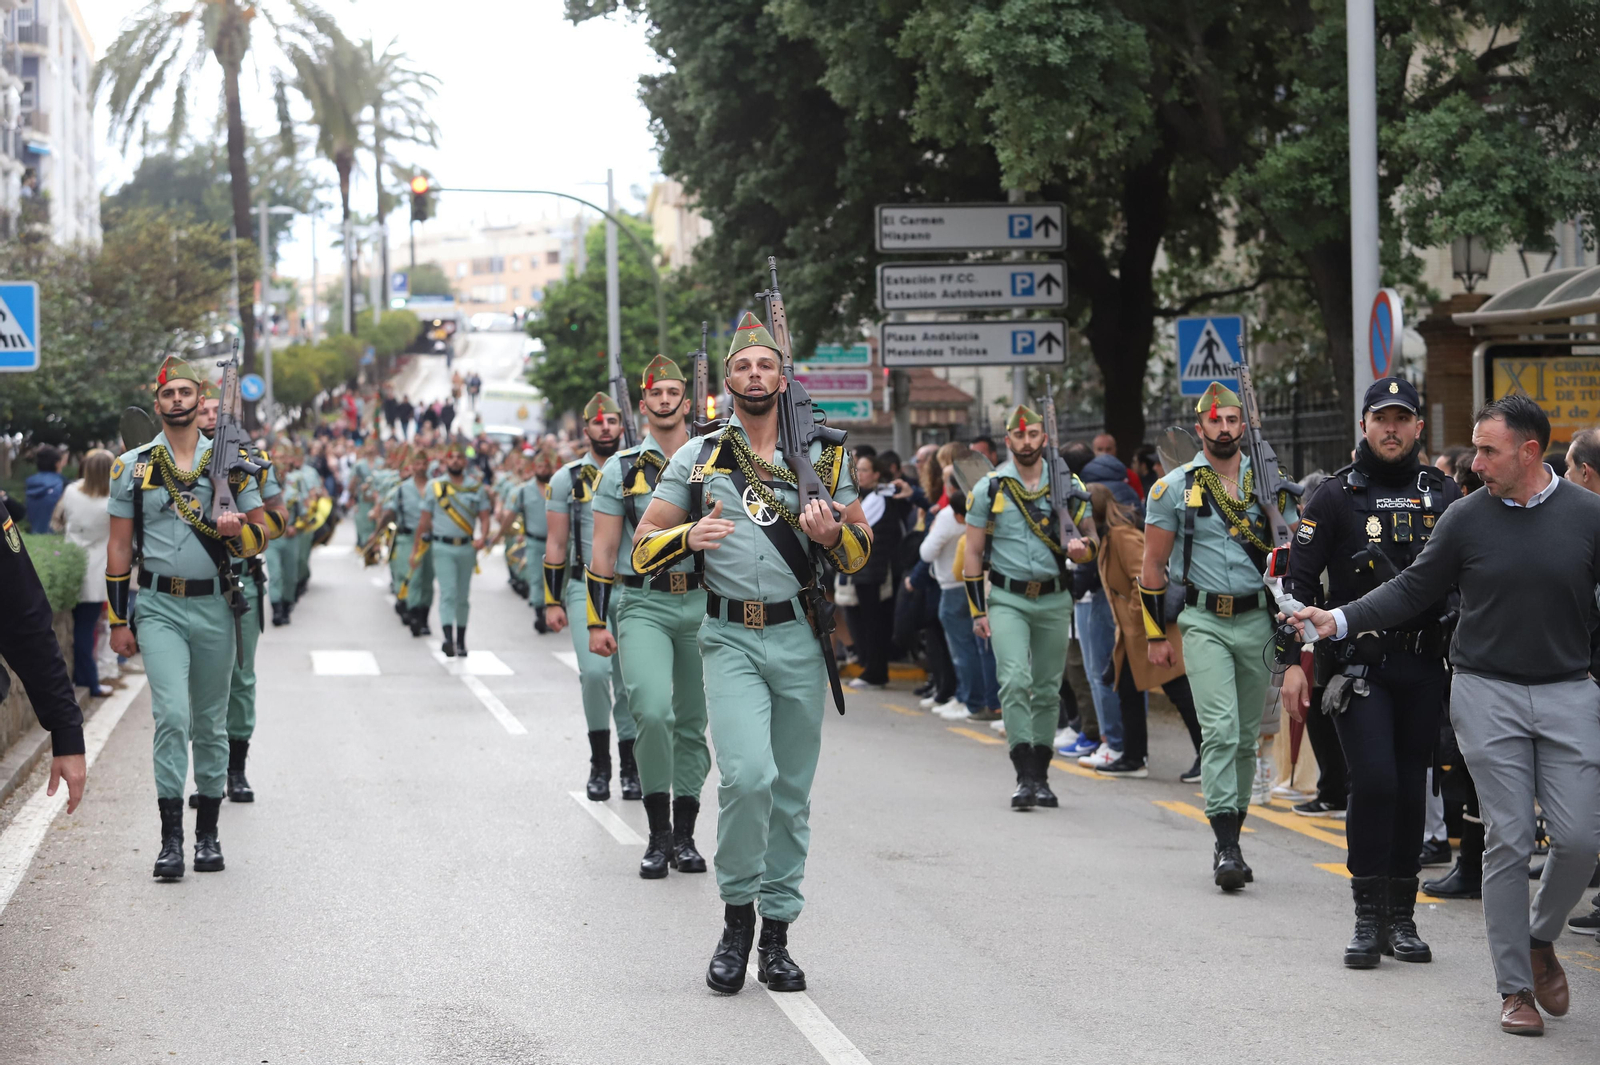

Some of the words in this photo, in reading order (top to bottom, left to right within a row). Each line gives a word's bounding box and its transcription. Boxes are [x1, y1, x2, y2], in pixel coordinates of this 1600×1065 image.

[882, 216, 895, 226] El
[900, 215, 945, 225] Carmen
[1012, 216, 1030, 237] P
[883, 231, 931, 242] Hispano
[886, 273, 936, 285] Estación
[1015, 274, 1033, 296] P
[886, 289, 937, 301] Estación
[941, 289, 1003, 300] Autobuses
[886, 332, 916, 342] Plaza
[1015, 333, 1033, 354] P
[950, 346, 988, 356] Tolosa
[1500, 362, 1548, 401] XI
[1554, 376, 1600, 387] INTER
[1555, 390, 1575, 401] DE
[1579, 390, 1600, 401] TU
[1568, 405, 1589, 418] de
